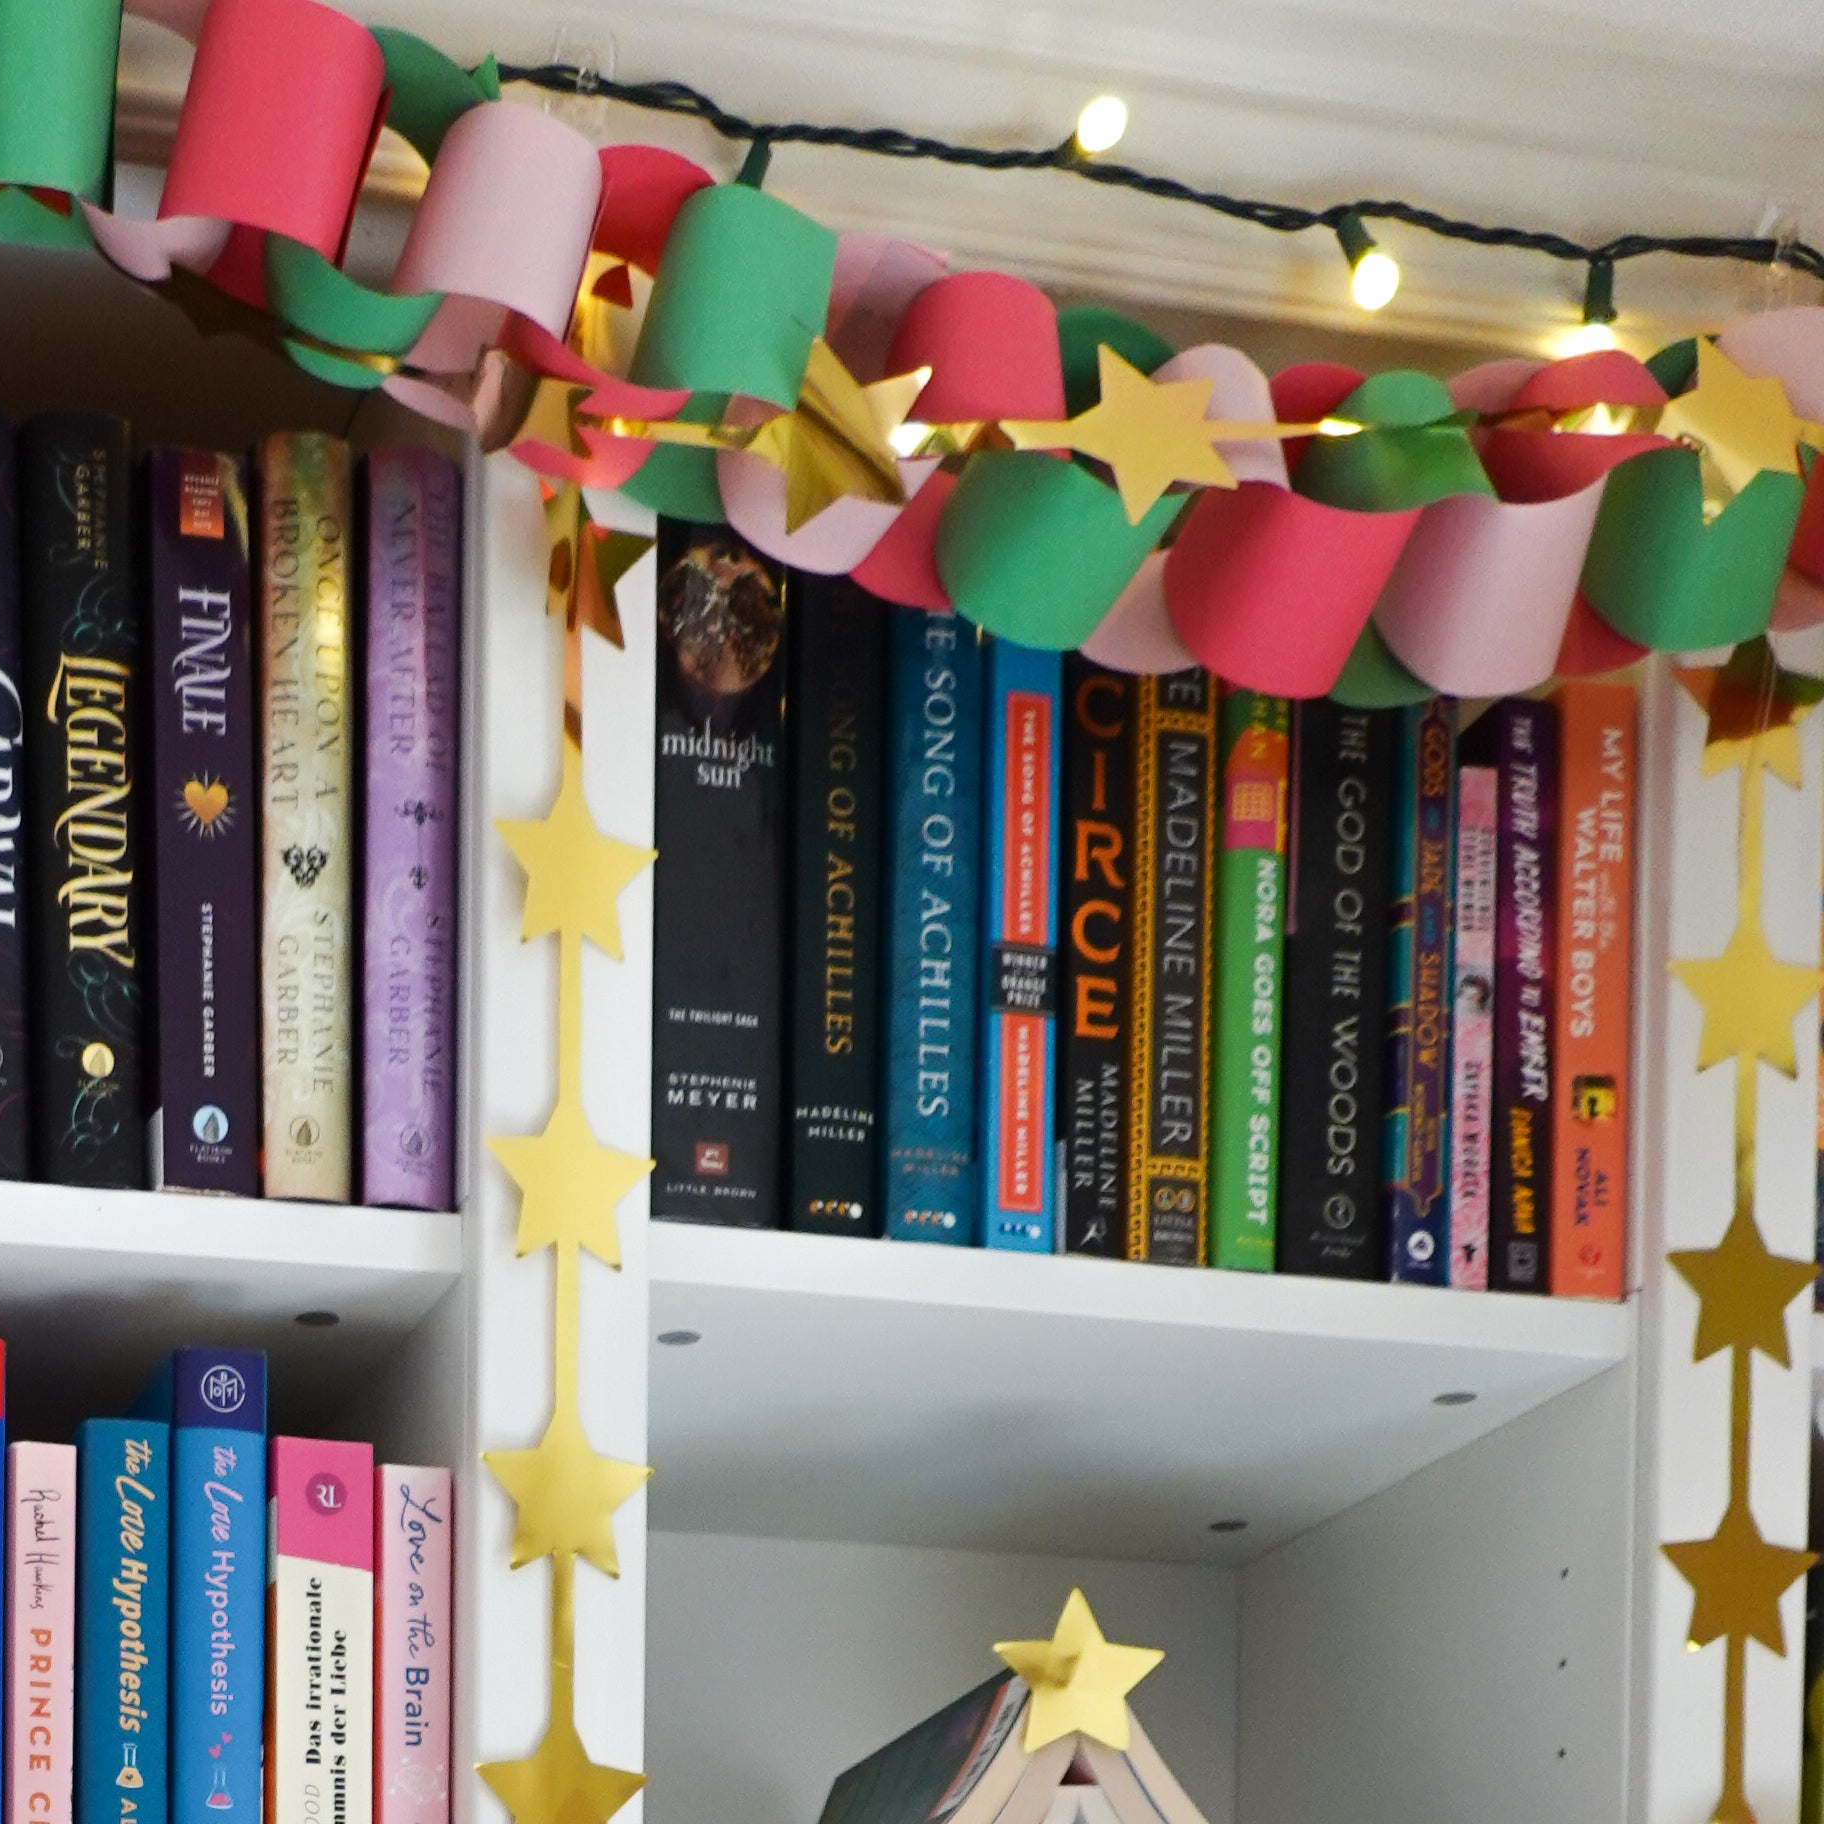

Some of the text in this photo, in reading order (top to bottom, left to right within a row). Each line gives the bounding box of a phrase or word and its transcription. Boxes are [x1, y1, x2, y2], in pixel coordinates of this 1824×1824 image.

[172, 585, 232, 739] FINALE
[660, 716, 775, 769] midnight
[47, 652, 133, 970] LEGENDARY
[696, 759, 743, 788] sun
[920, 668, 955, 1120] SONG OF ACHILLES
[1072, 676, 1124, 1040] CIRCE
[1247, 860, 1277, 1227] NORA GOES OFF SCRIPT
[204, 1550, 236, 1717] Hypothesis
[305, 1577, 322, 1764] Das irrationale
[330, 1629, 347, 1696] Liebe
[400, 1482, 438, 1749] Love on the Brain
[28, 1628, 52, 1772] PRINCE
[330, 1705, 346, 1745] der
